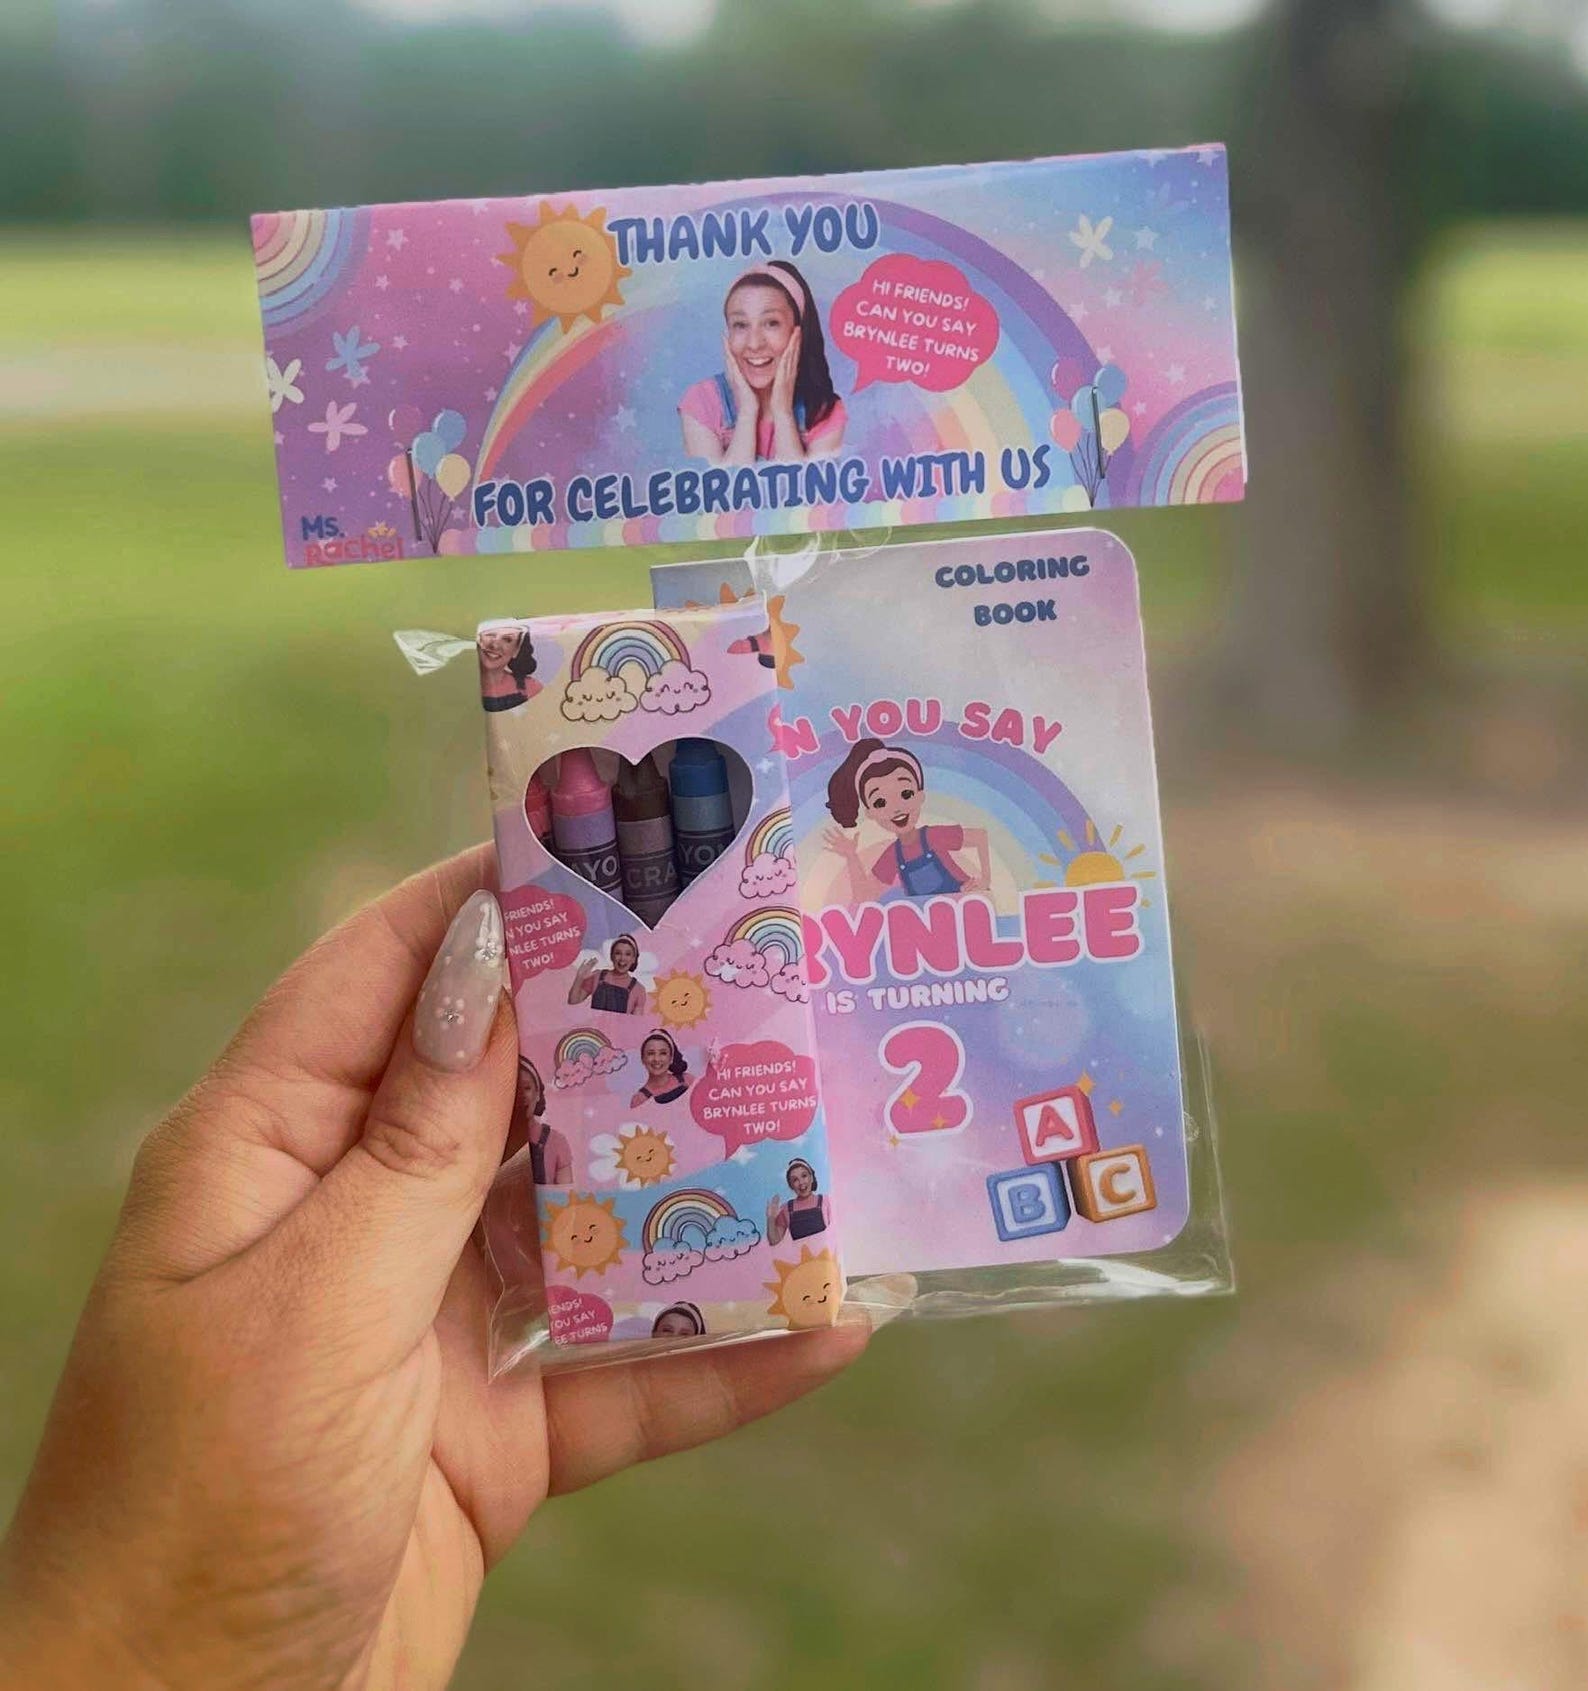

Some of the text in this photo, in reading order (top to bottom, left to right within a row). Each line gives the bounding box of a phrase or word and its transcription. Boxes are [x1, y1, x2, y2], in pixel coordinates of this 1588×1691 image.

[606, 203, 879, 266] THANK YOU
[873, 280, 970, 312] HI FRIENDS!
[856, 300, 977, 337] CAN YOU SAY
[843, 321, 980, 363] BRYNLEE TURNS
[886, 355, 931, 377] TWO!
[474, 444, 1051, 527] FOR CELEBRATING WITH US
[934, 554, 1091, 589] COLORING
[973, 599, 1058, 627] BOOK
[830, 699, 942, 742] YOU
[958, 700, 1062, 754] SAY
[581, 855, 619, 881] YO
[625, 861, 677, 889] CRA
[515, 921, 541, 937] YOU
[543, 911, 568, 928] SAY
[803, 885, 1141, 985] YNLEE
[509, 925, 581, 956] NLEE TURNS
[522, 952, 554, 969] TWO!
[826, 977, 1010, 1015] IS TURNING
[716, 1060, 797, 1080] HI FRIENDS!
[882, 1023, 969, 1135] 2
[708, 1077, 808, 1101] CAN YOU SAY
[702, 1095, 817, 1120] BRYNLEE TURNS
[743, 1119, 780, 1135] TWO!
[1034, 1104, 1075, 1148] A
[1098, 1162, 1135, 1205] C
[1006, 1183, 1046, 1225] B
[550, 1298, 583, 1315] ENDS!
[572, 1309, 596, 1324] SAY
